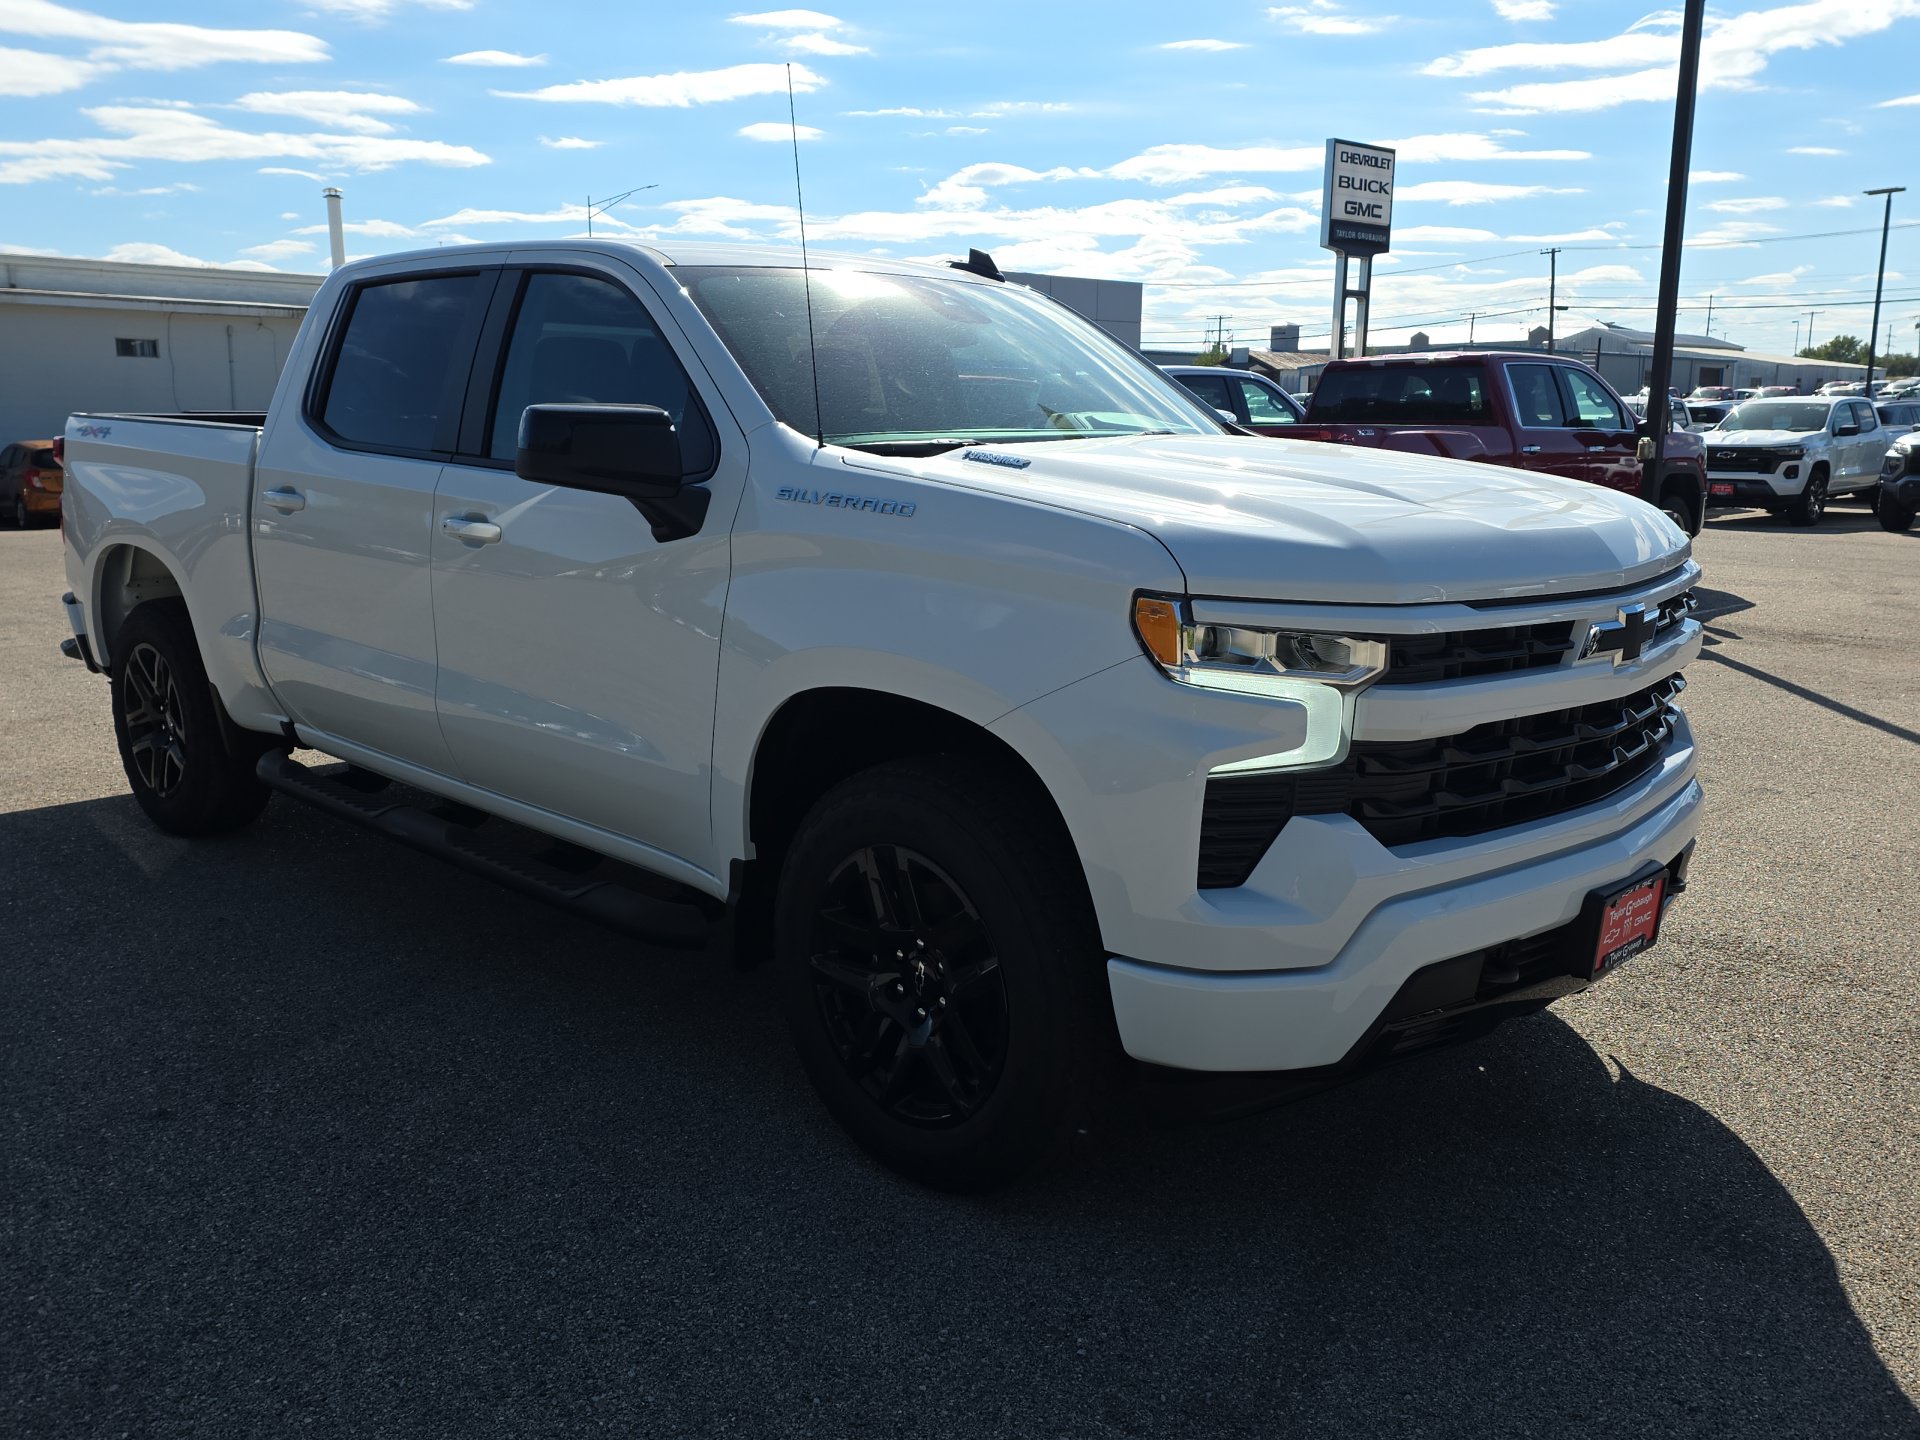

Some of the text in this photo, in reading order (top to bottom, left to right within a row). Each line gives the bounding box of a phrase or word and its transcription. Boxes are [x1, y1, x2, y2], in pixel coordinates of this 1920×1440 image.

[1340, 151, 1392, 170] CHEVROLET
[1338, 174, 1390, 195] BUICK
[1344, 200, 1383, 219] GMC
[1336, 229, 1356, 239] TAYLOR
[775, 486, 917, 518] SILVERADO
[1609, 907, 1626, 926] Taylor
[1634, 910, 1653, 927] GMC
